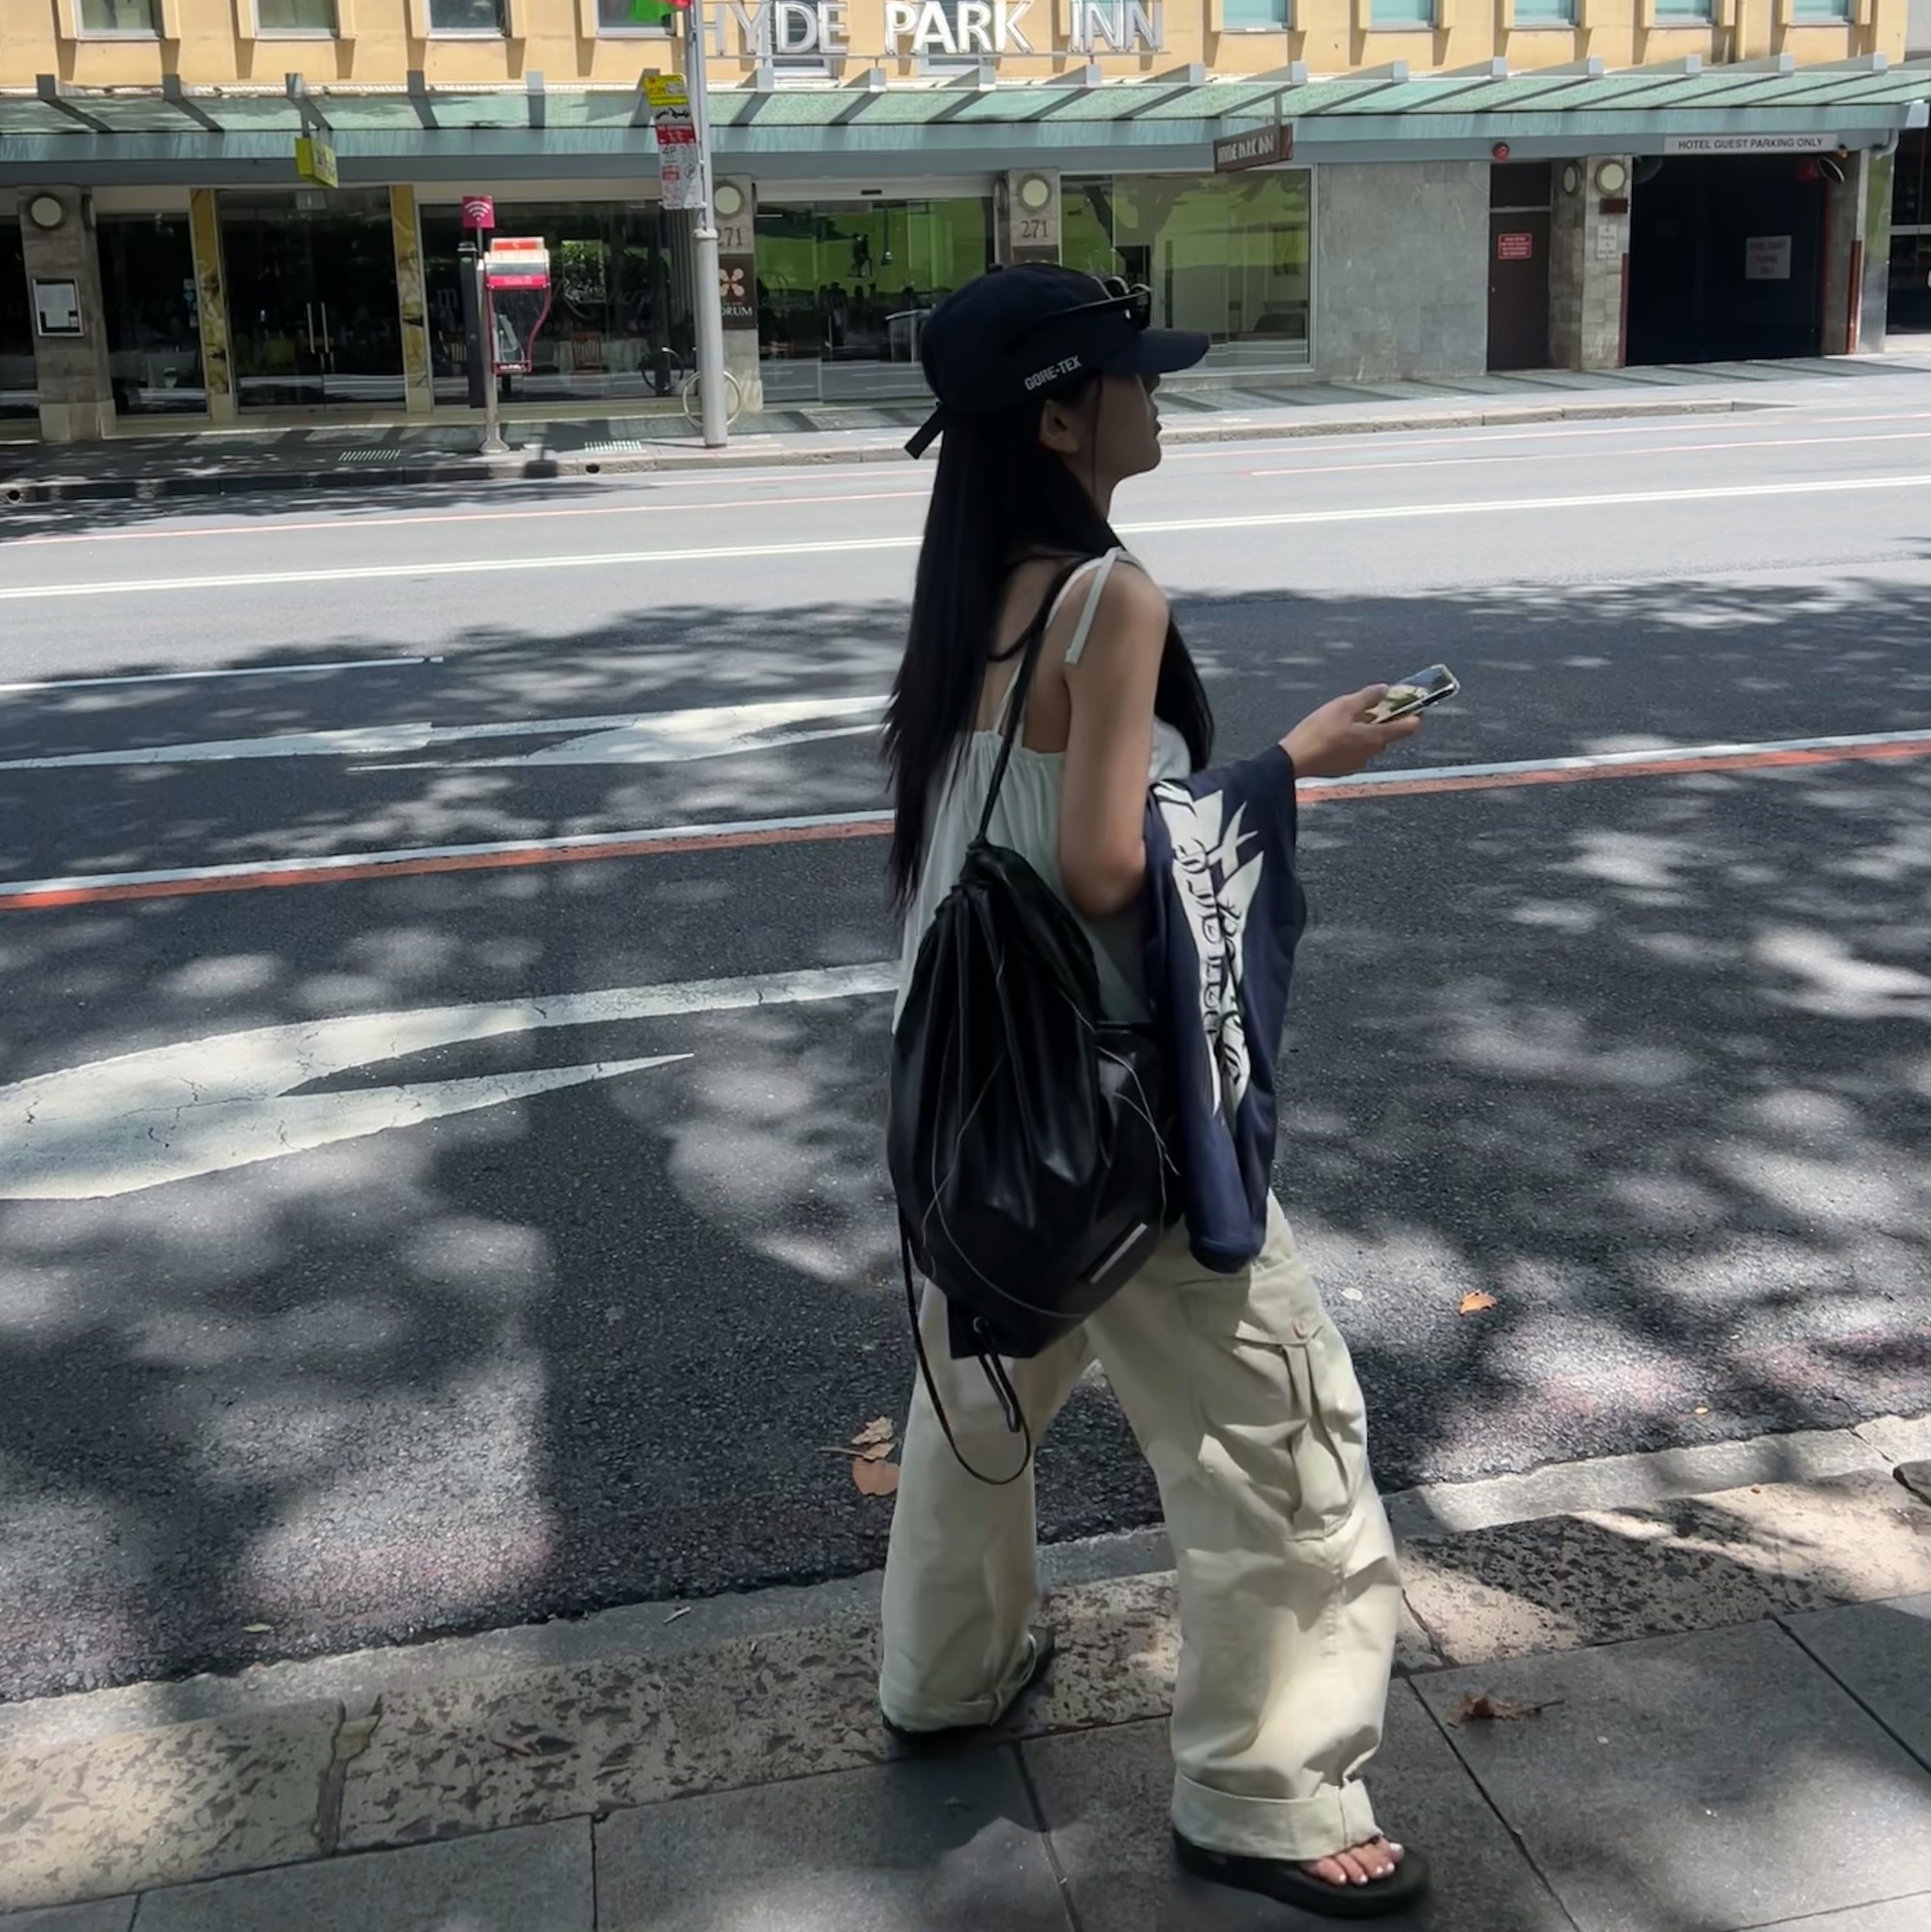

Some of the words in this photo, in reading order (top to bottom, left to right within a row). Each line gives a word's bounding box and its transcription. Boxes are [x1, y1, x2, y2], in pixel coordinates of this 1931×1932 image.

[884, 0, 1033, 55] PARK
[1069, 0, 1163, 52] INN
[1677, 139, 1712, 150] HOTEL
[1713, 138, 1748, 149] GUEST
[1750, 137, 1795, 148] PARKING
[1796, 137, 1823, 148] ONLY
[1021, 219, 1048, 240] 271
[1024, 355, 1082, 391] GORE-TEX
